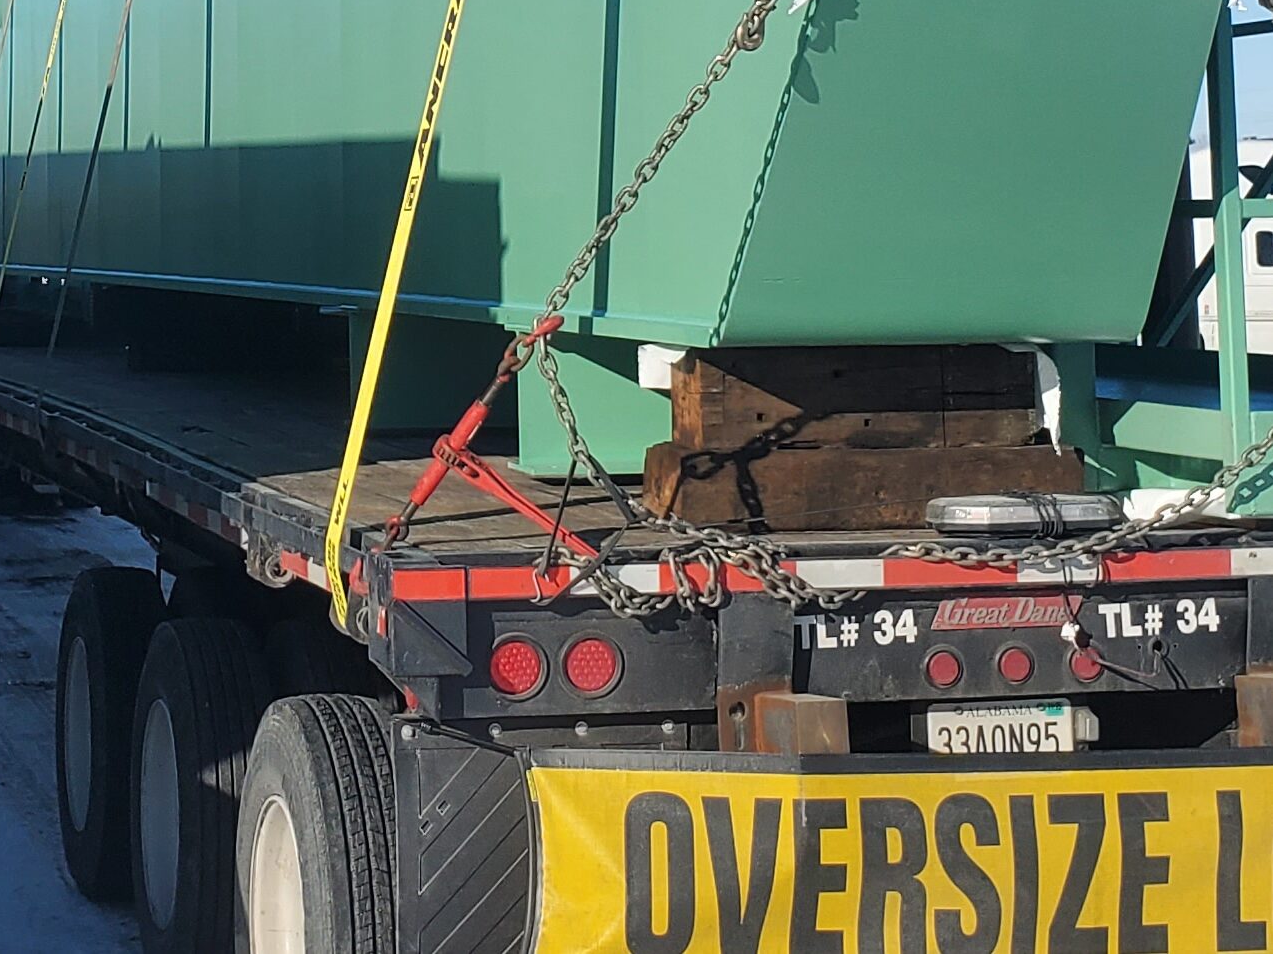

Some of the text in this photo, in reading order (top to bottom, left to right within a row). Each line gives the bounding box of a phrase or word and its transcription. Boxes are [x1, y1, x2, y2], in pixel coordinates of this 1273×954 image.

[794, 608, 918, 650] TL# 34
[942, 597, 1012, 626] Great
[1098, 596, 1220, 639] TL# 34
[965, 703, 1034, 718] ALABAMA
[625, 790, 1171, 954] OVERSIZE
